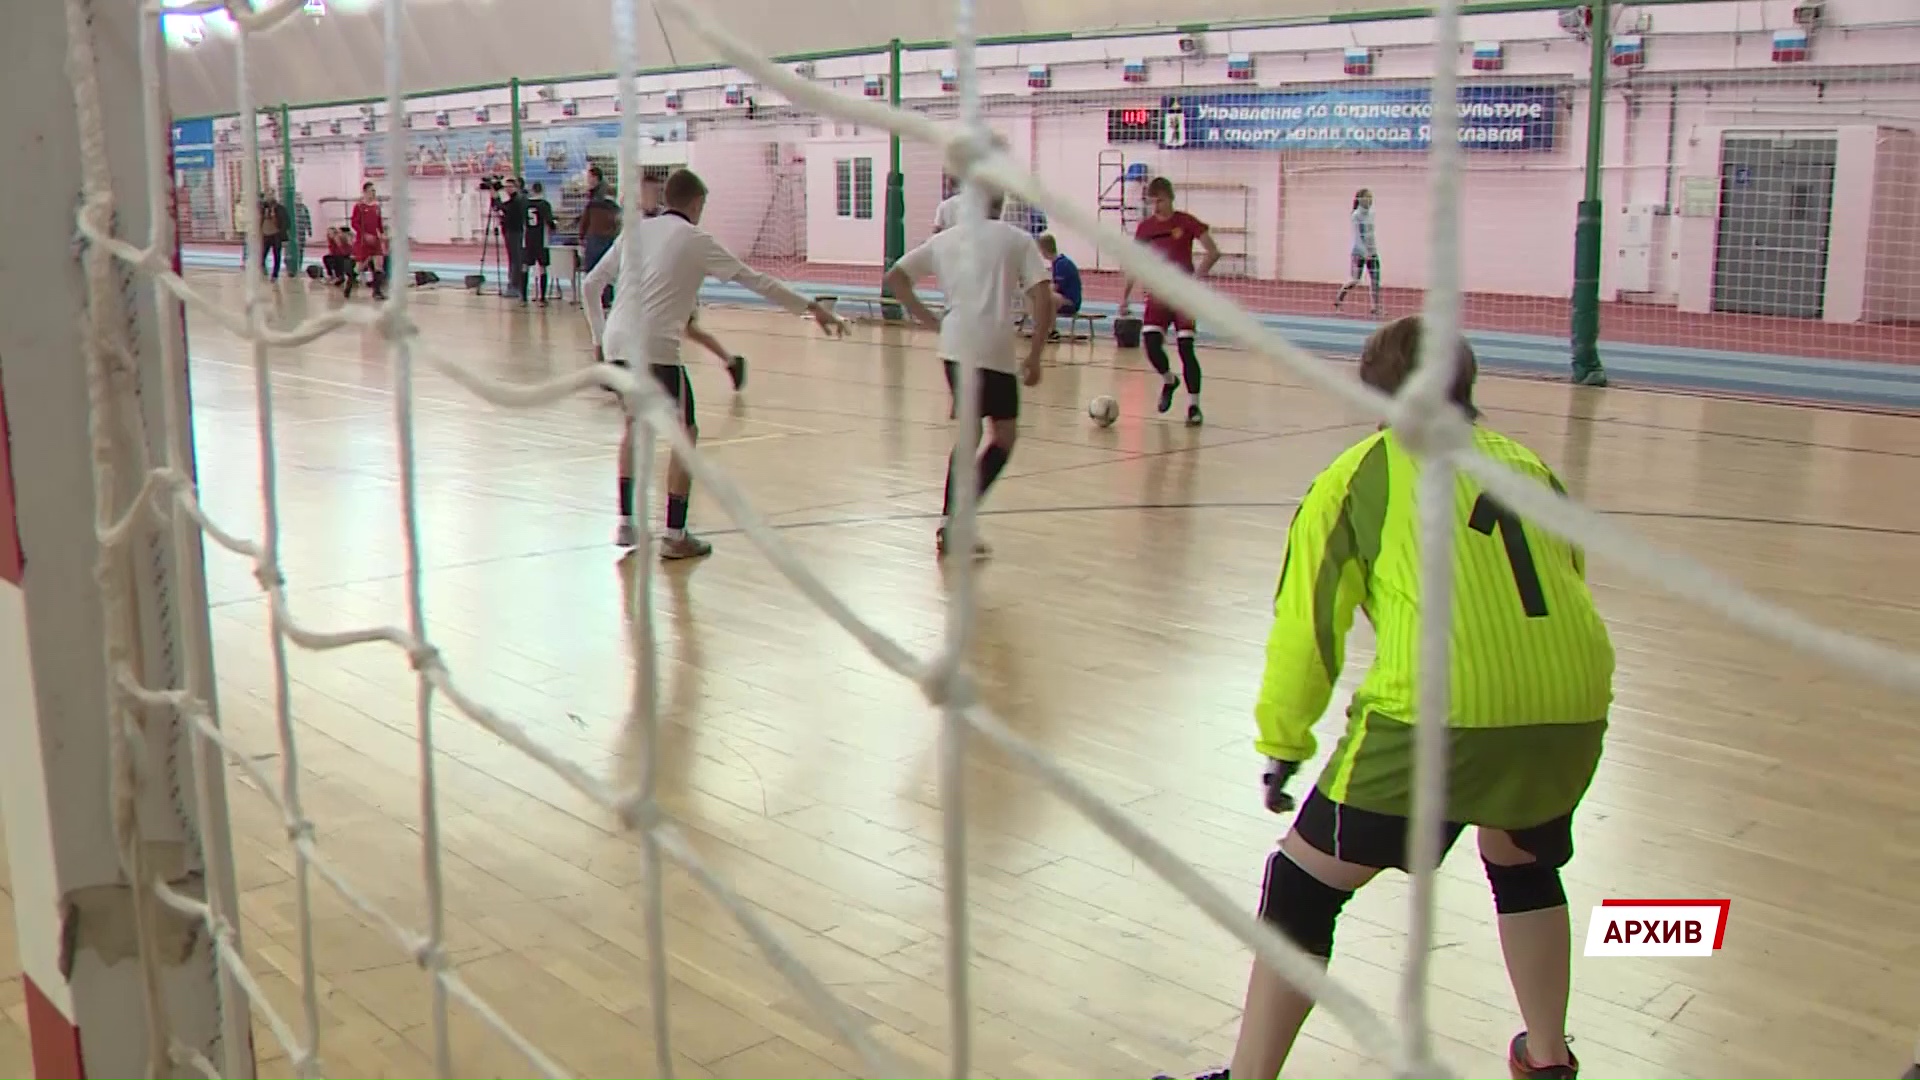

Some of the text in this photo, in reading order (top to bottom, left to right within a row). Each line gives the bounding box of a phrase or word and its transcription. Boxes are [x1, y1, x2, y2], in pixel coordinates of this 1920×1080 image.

[1198, 102, 1542, 120] Управление по физическо ультуре
[1224, 127, 1280, 142] спорту
[1346, 126, 1412, 141] города
[1418, 124, 1524, 142] Яславля
[527, 207, 539, 226] 5
[1468, 492, 1549, 617] 1
